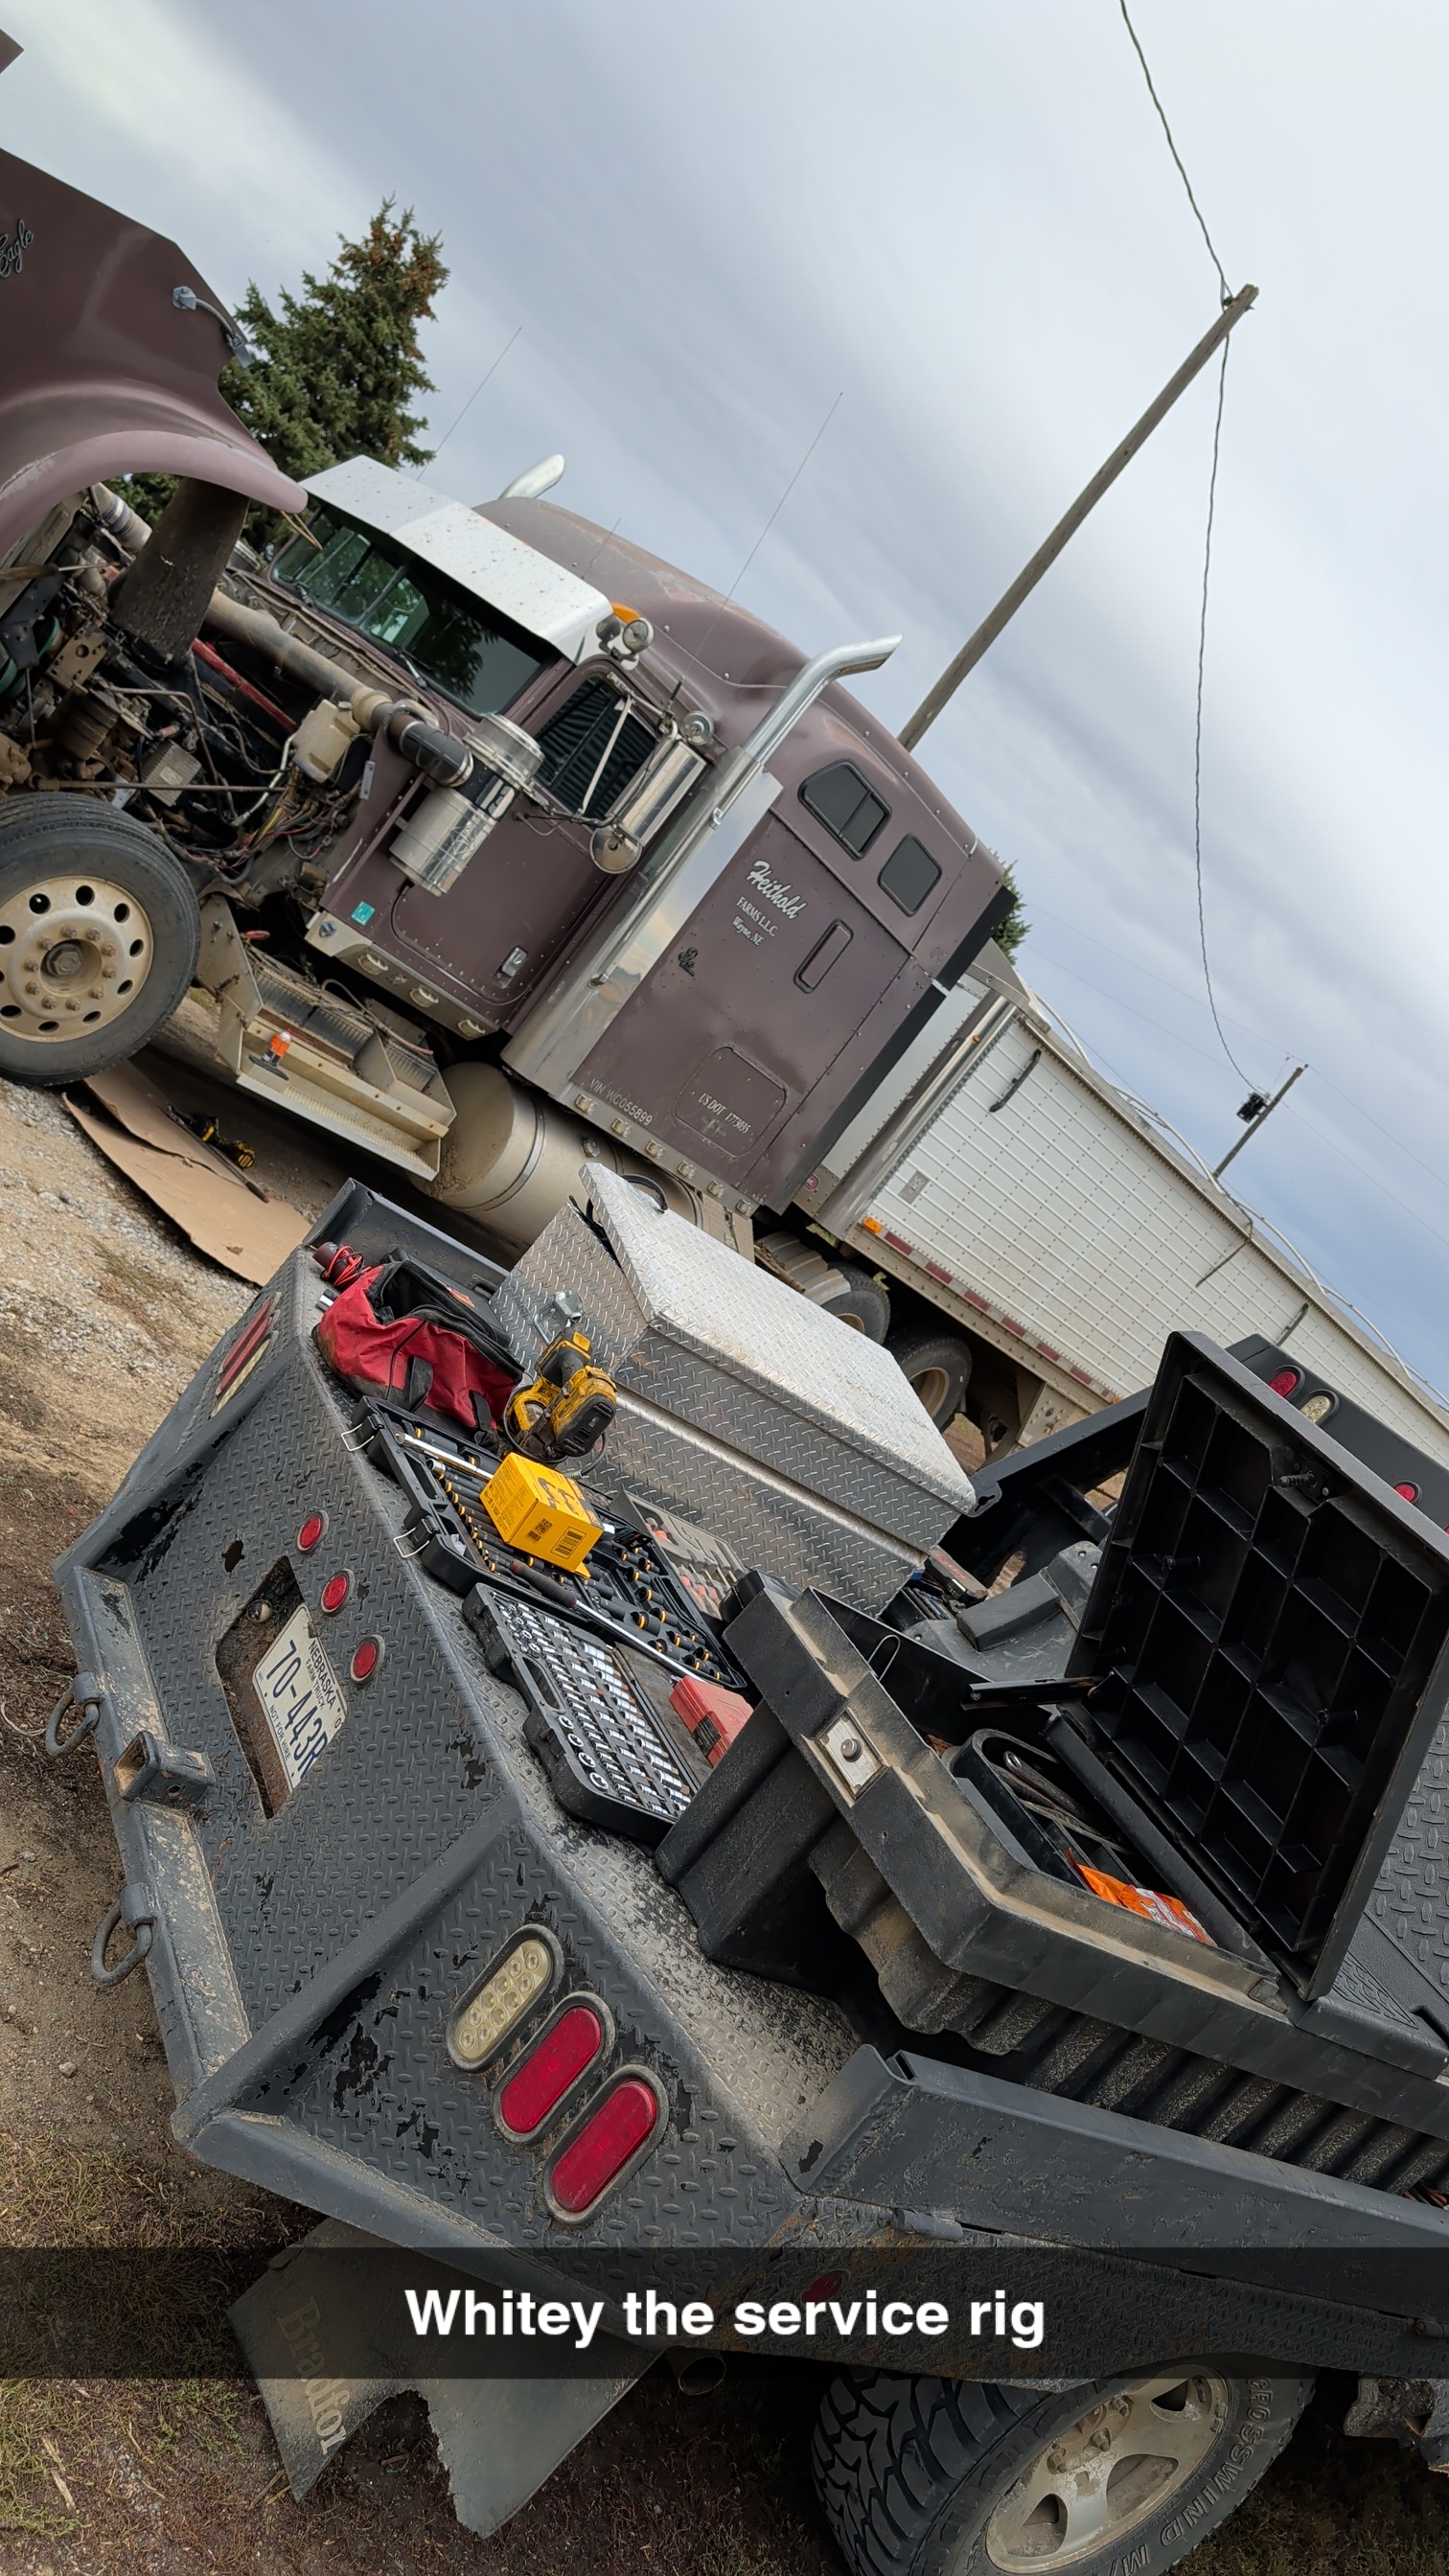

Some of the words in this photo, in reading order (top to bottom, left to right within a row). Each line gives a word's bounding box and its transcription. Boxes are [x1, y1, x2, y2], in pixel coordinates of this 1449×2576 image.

[736, 896, 763, 922] FARMS
[747, 861, 806, 919] Heithold
[750, 933, 765, 946] NE
[589, 1077, 607, 1094] VIN
[698, 1092, 710, 1106] US
[707, 1100, 727, 1116] DOT
[305, 1658, 316, 1683] FARM
[312, 1679, 326, 1712] TRUCK
[308, 1639, 336, 1711] NEBRASKA
[265, 1639, 328, 1780] 70-443R
[268, 1704, 280, 1722] NOT
[274, 1721, 285, 1740] FOR
[281, 1738, 291, 1763] HIRE
[1160, 2376, 1274, 2547] CROSSWIND
